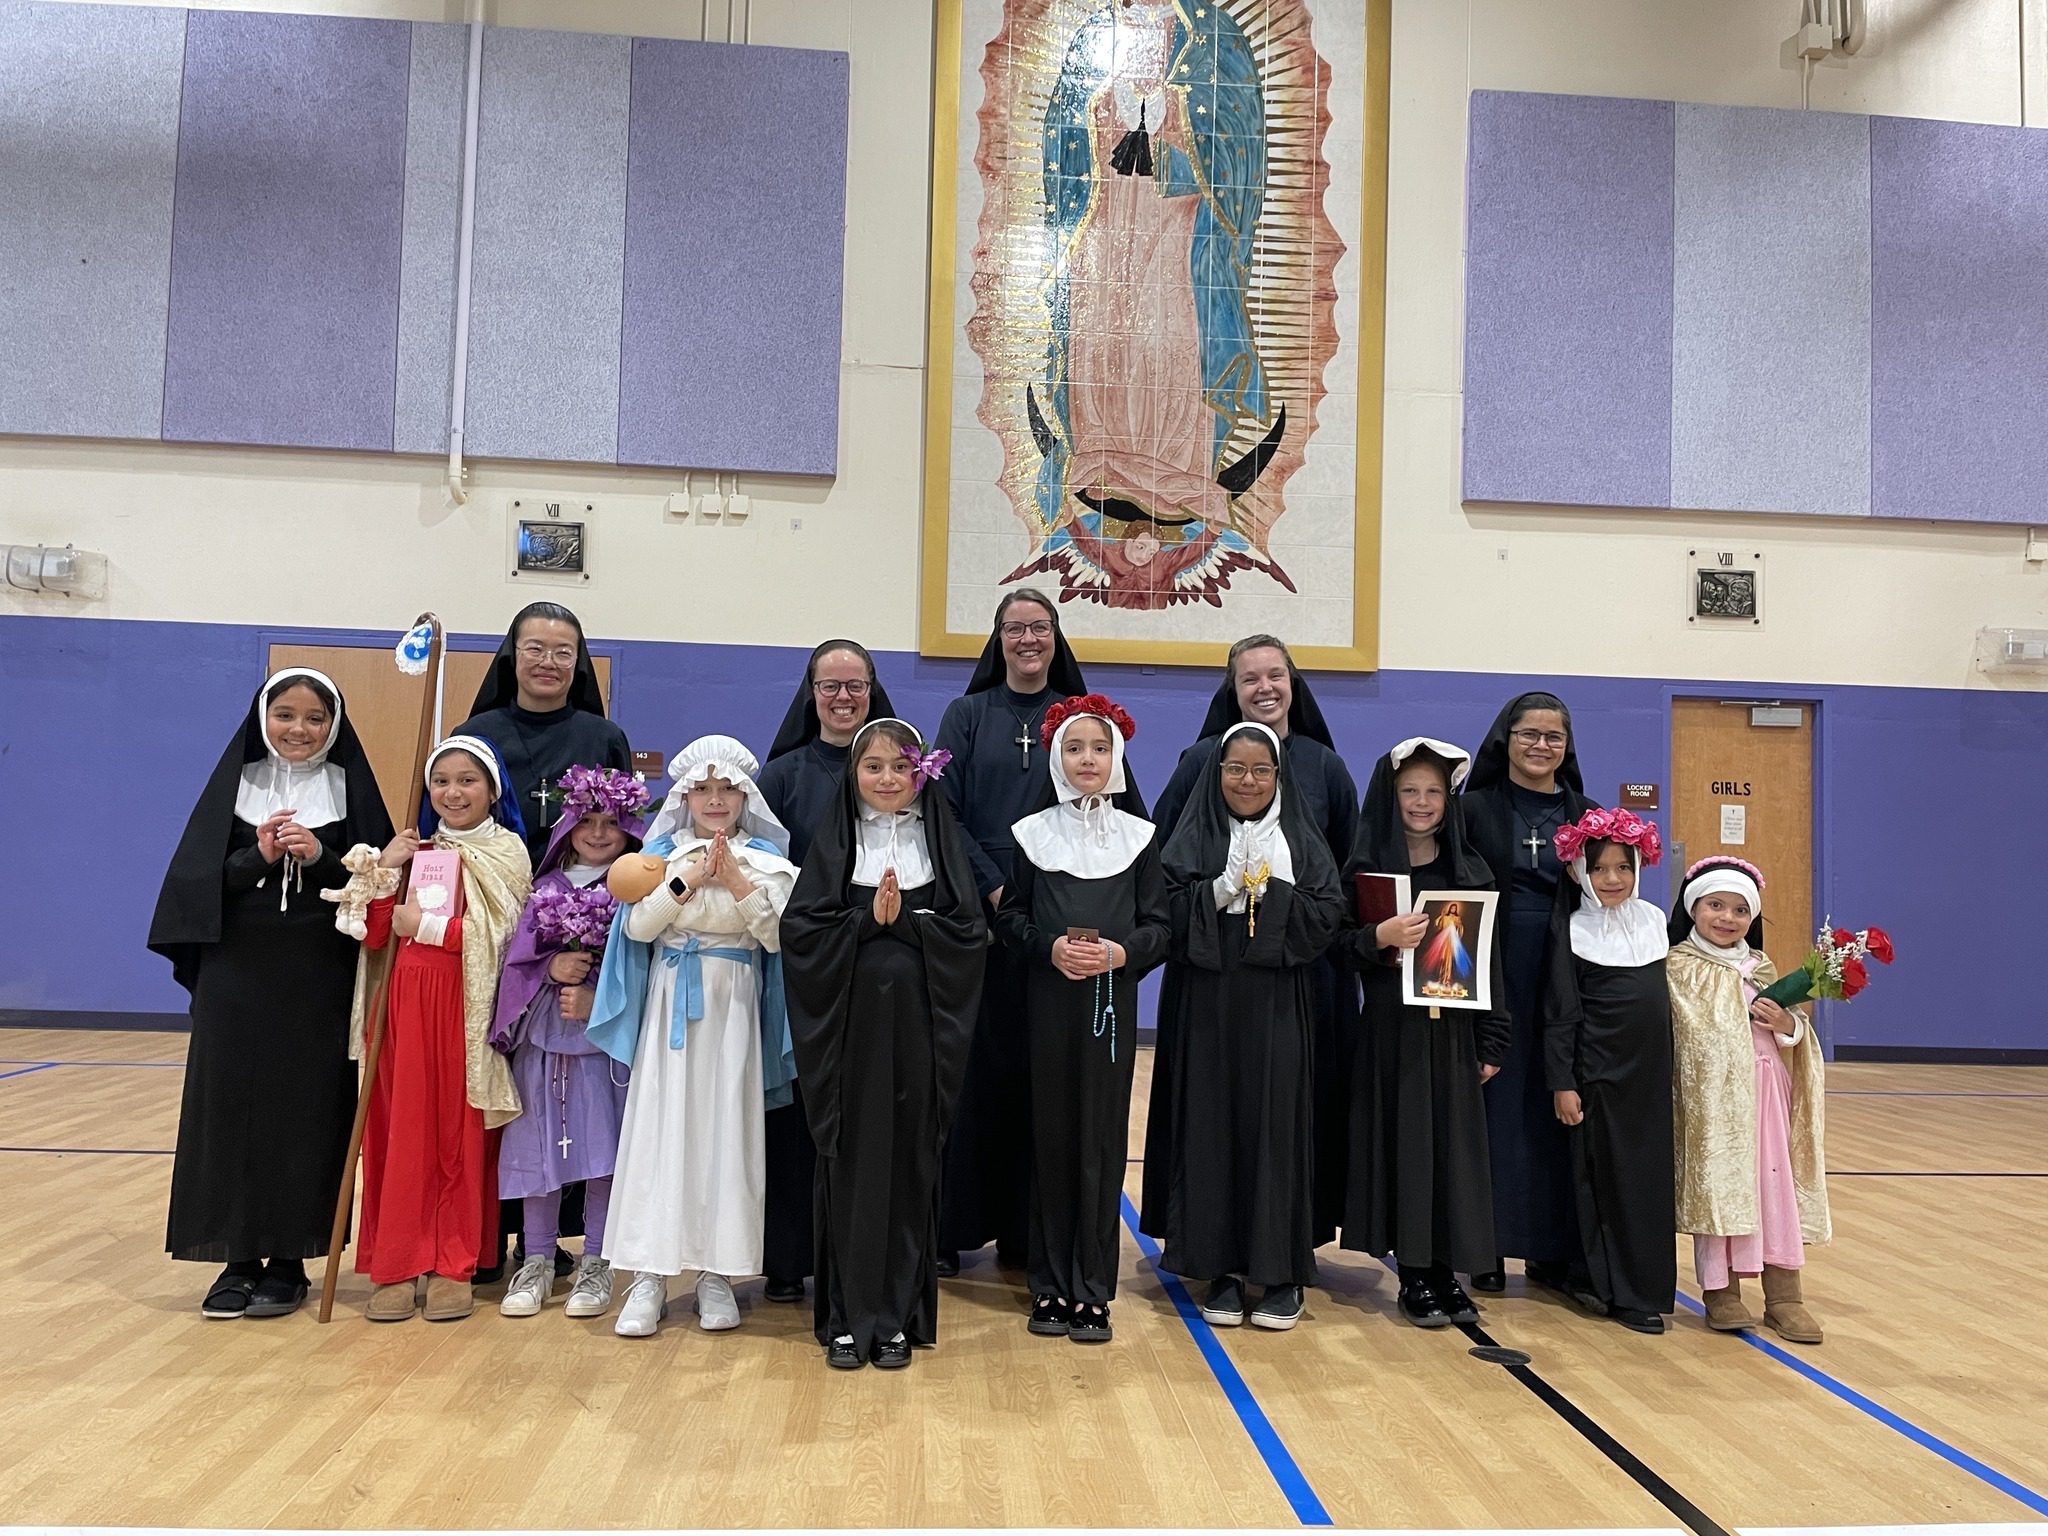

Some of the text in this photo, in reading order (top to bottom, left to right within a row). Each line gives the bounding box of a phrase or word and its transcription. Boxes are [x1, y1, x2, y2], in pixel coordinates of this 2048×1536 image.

[545, 503, 560, 517] VII
[1717, 552, 1733, 566] VIII
[1711, 781, 1751, 796] GIRLS
